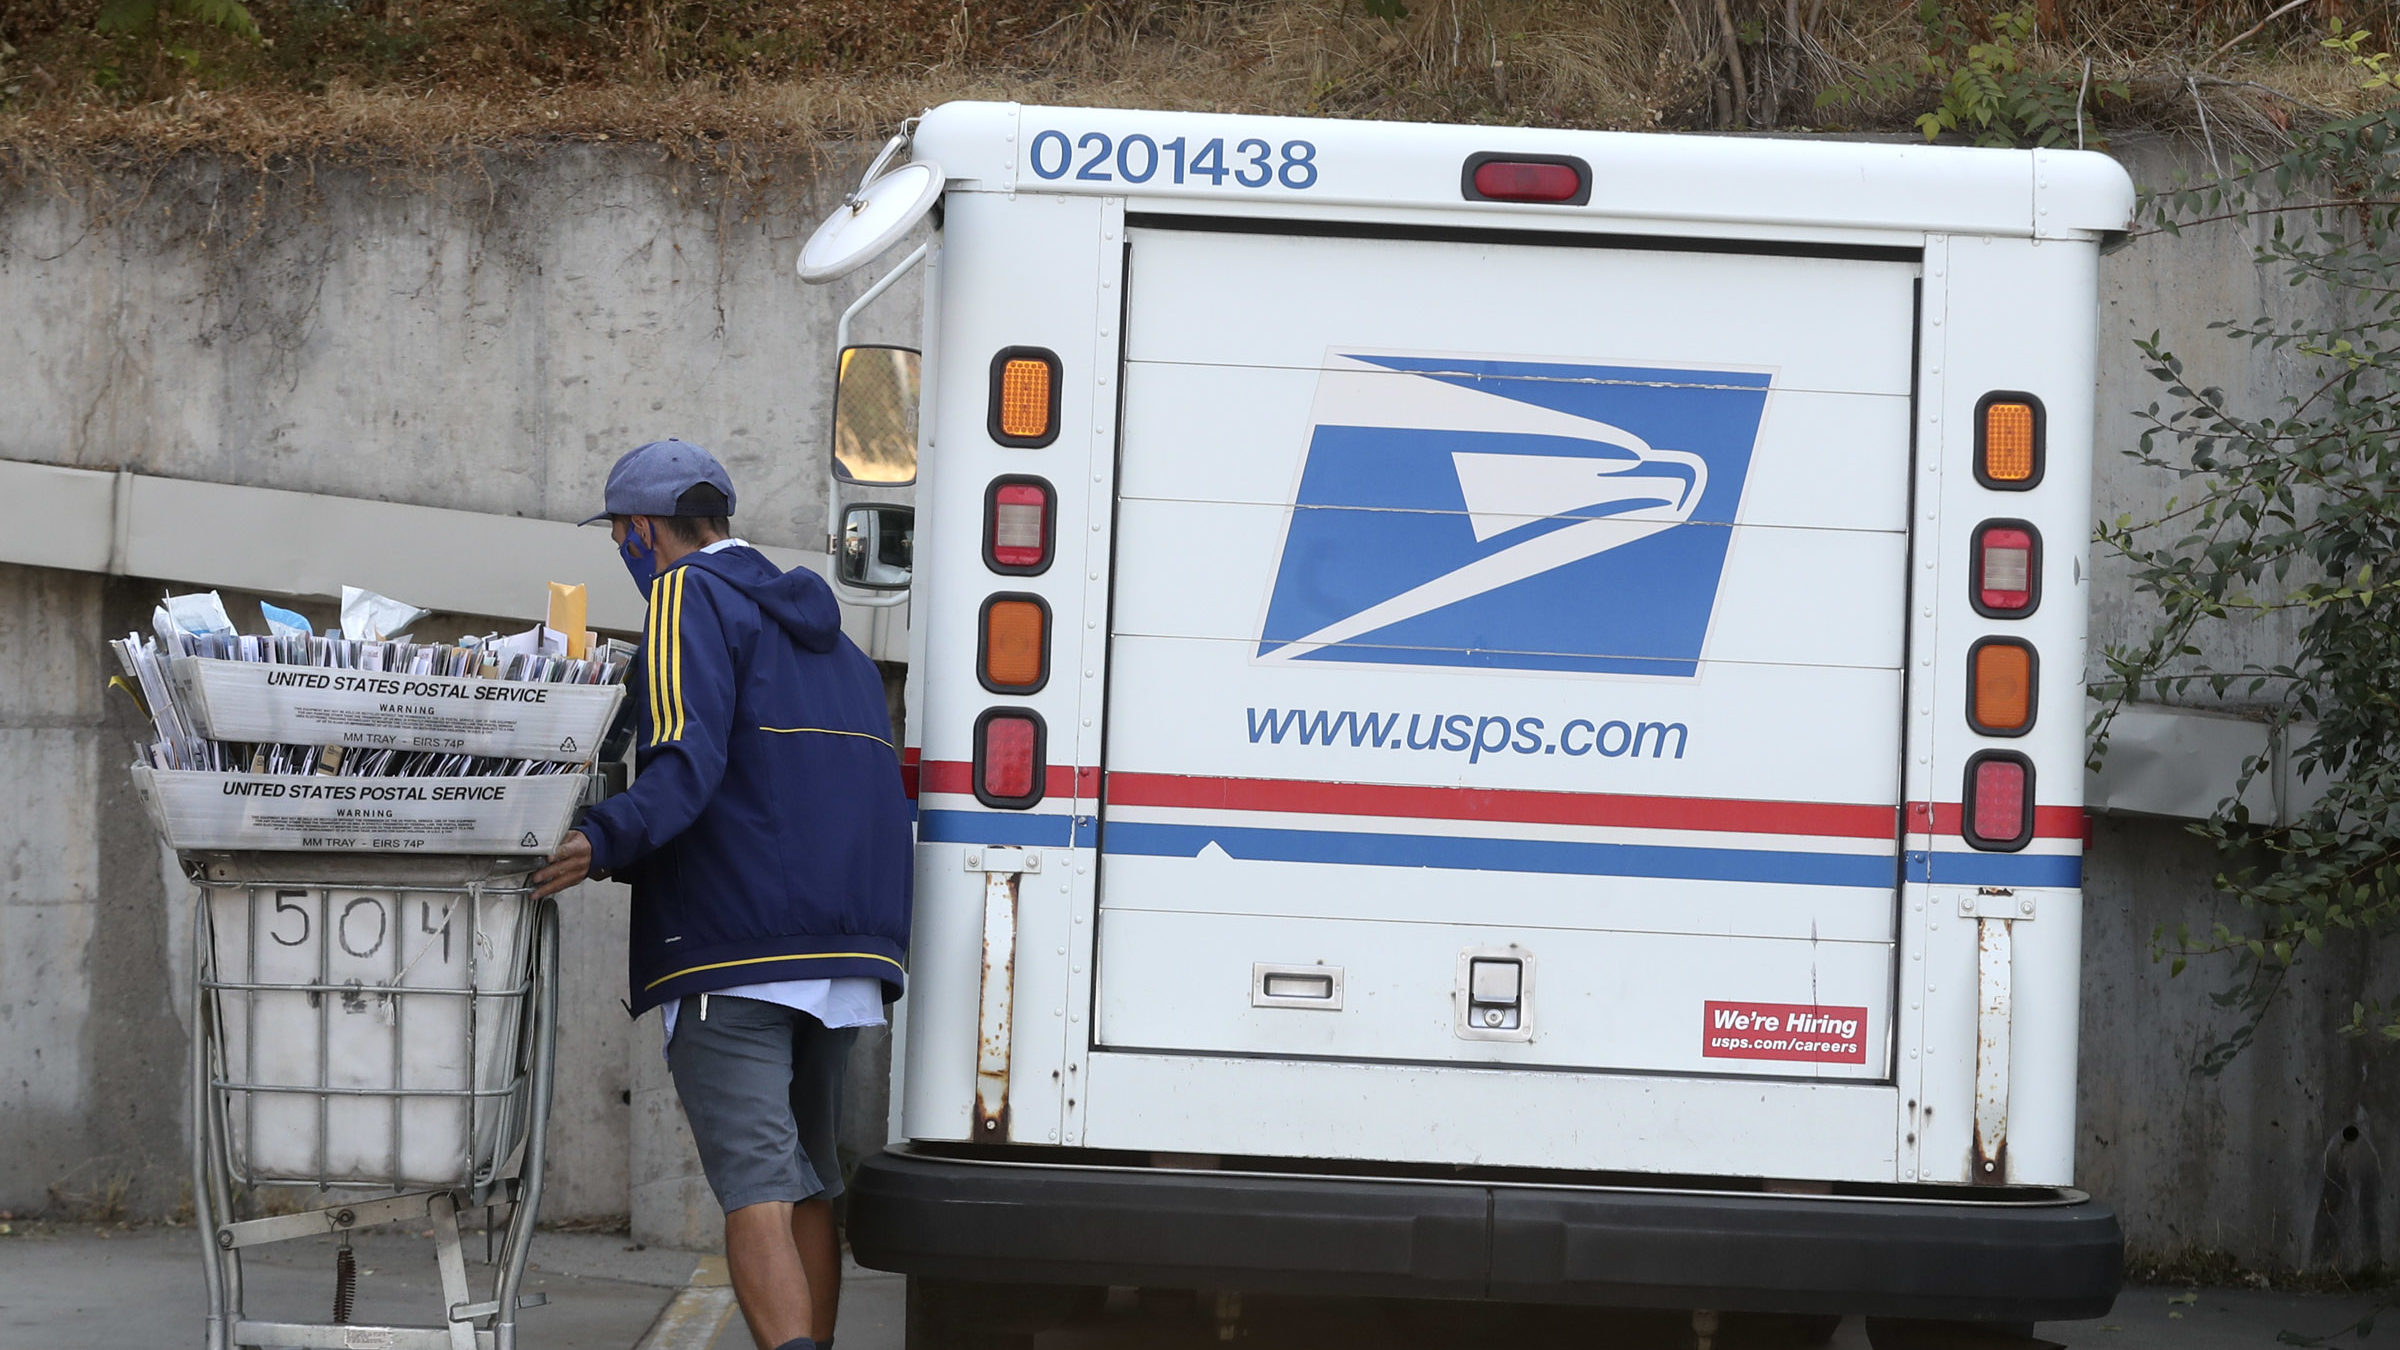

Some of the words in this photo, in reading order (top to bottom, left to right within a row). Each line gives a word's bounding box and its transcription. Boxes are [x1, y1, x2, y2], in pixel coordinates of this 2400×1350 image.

[1030, 129, 1318, 189] 0201438
[267, 671, 330, 689] UNITED
[333, 676, 400, 695] STATES
[403, 681, 470, 699] POSTAL
[474, 686, 549, 703] SERVICE
[379, 703, 435, 715] WARNING
[343, 732, 363, 743] MM
[366, 733, 397, 744] TRAY
[413, 736, 440, 748] EIRS
[443, 738, 465, 749] 74P
[1246, 707, 1689, 764] www.usps.com
[222, 781, 286, 797] UNITED
[289, 784, 357, 800] STATES
[360, 786, 428, 801] POSTAL
[431, 786, 506, 801] SERVICE
[336, 808, 393, 818] WARNING
[302, 837, 322, 847] MM
[326, 838, 357, 848] TRAY
[372, 839, 401, 848] EIRS
[403, 839, 425, 848] 74P
[270, 889, 451, 964] 504
[1713, 1009, 1780, 1032] We're
[1785, 1012, 1858, 1039] Hiring
[1711, 1037, 1858, 1054] usps.com/careers
